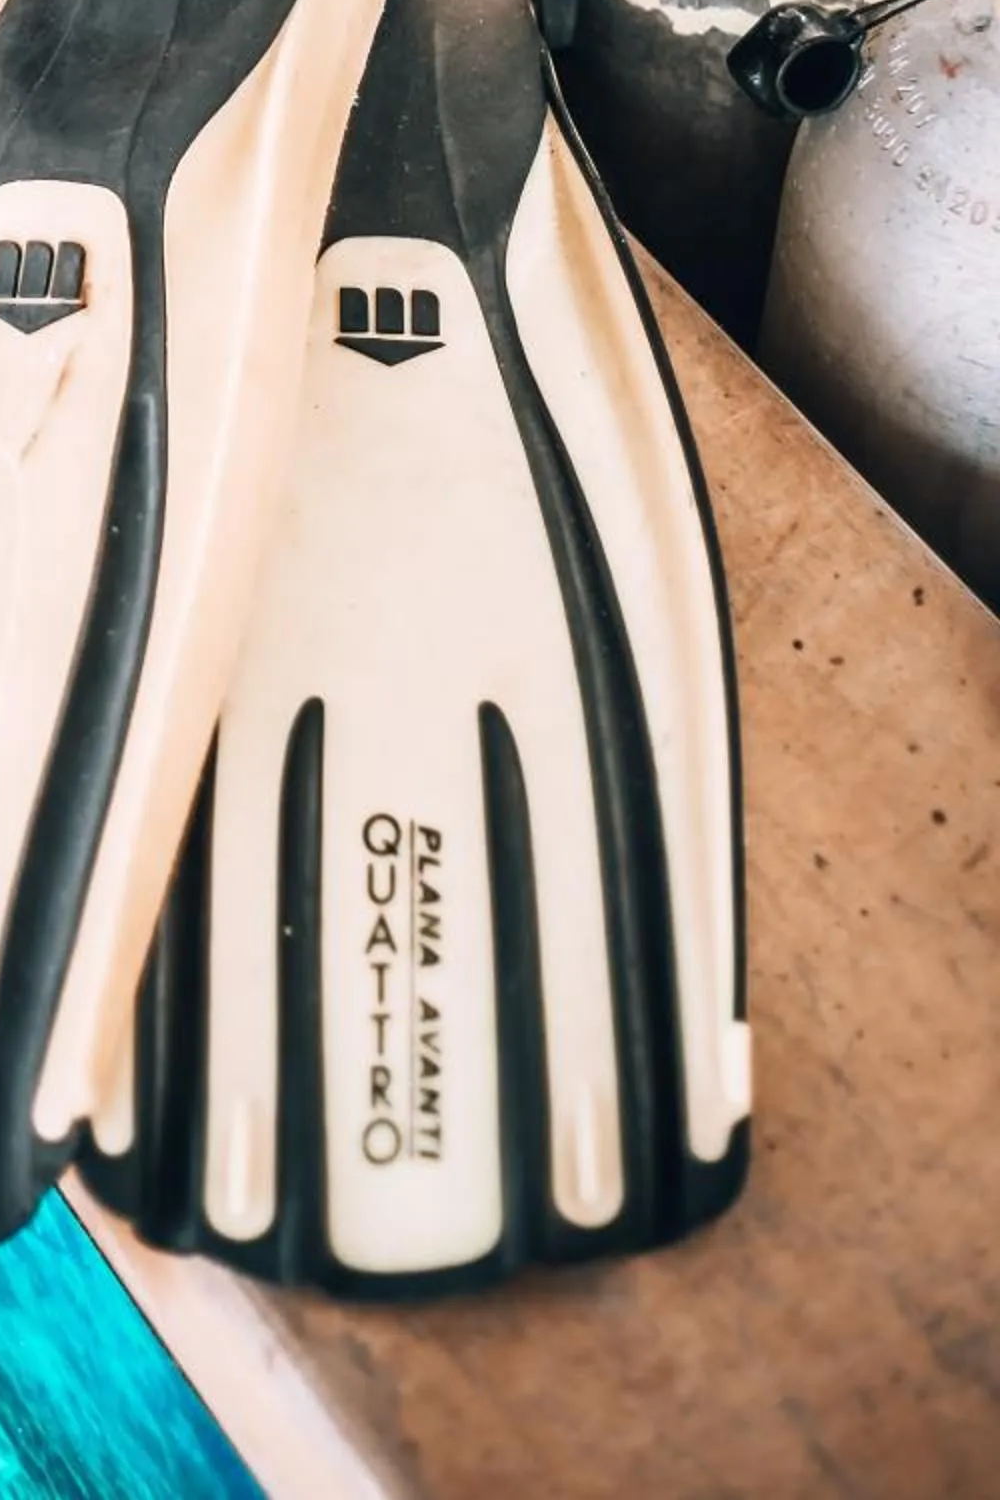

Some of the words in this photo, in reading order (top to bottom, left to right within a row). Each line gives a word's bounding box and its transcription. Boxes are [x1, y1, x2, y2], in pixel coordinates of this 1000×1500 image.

[417, 825, 442, 968] PLANA
[362, 812, 402, 1166] QUATTRO
[418, 996, 441, 1160] AVANTI
